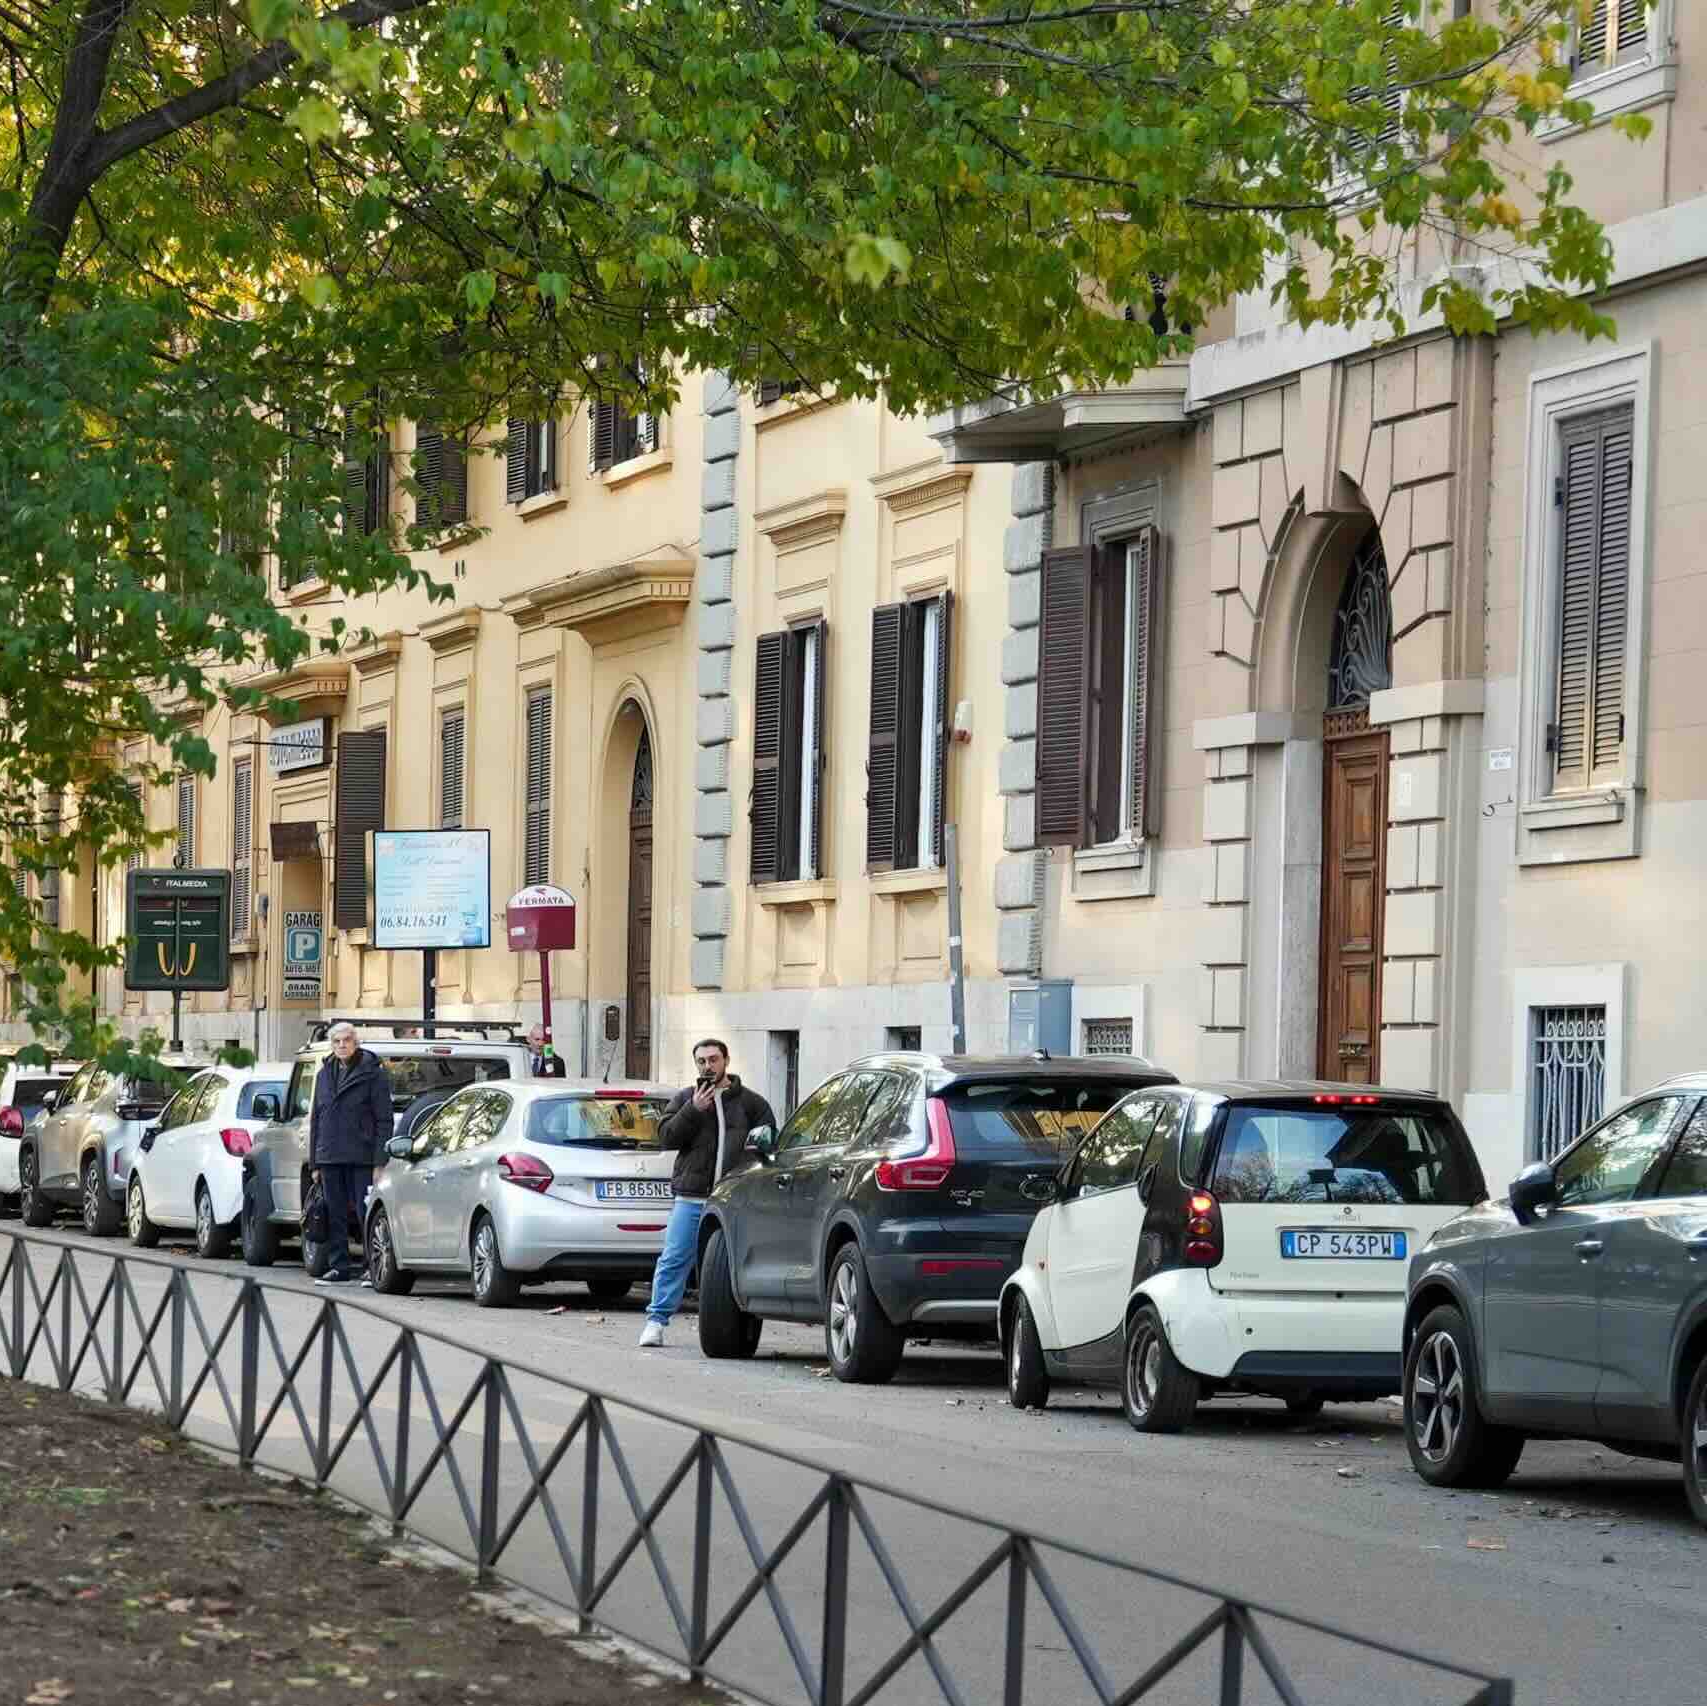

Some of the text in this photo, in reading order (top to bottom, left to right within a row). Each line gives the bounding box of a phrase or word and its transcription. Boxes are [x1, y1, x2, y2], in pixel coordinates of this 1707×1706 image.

[519, 896, 564, 905] FERMATA
[286, 911, 323, 928] GARAG
[607, 1182, 624, 1196] FB
[1297, 1234, 1393, 1255] CP 543PW
